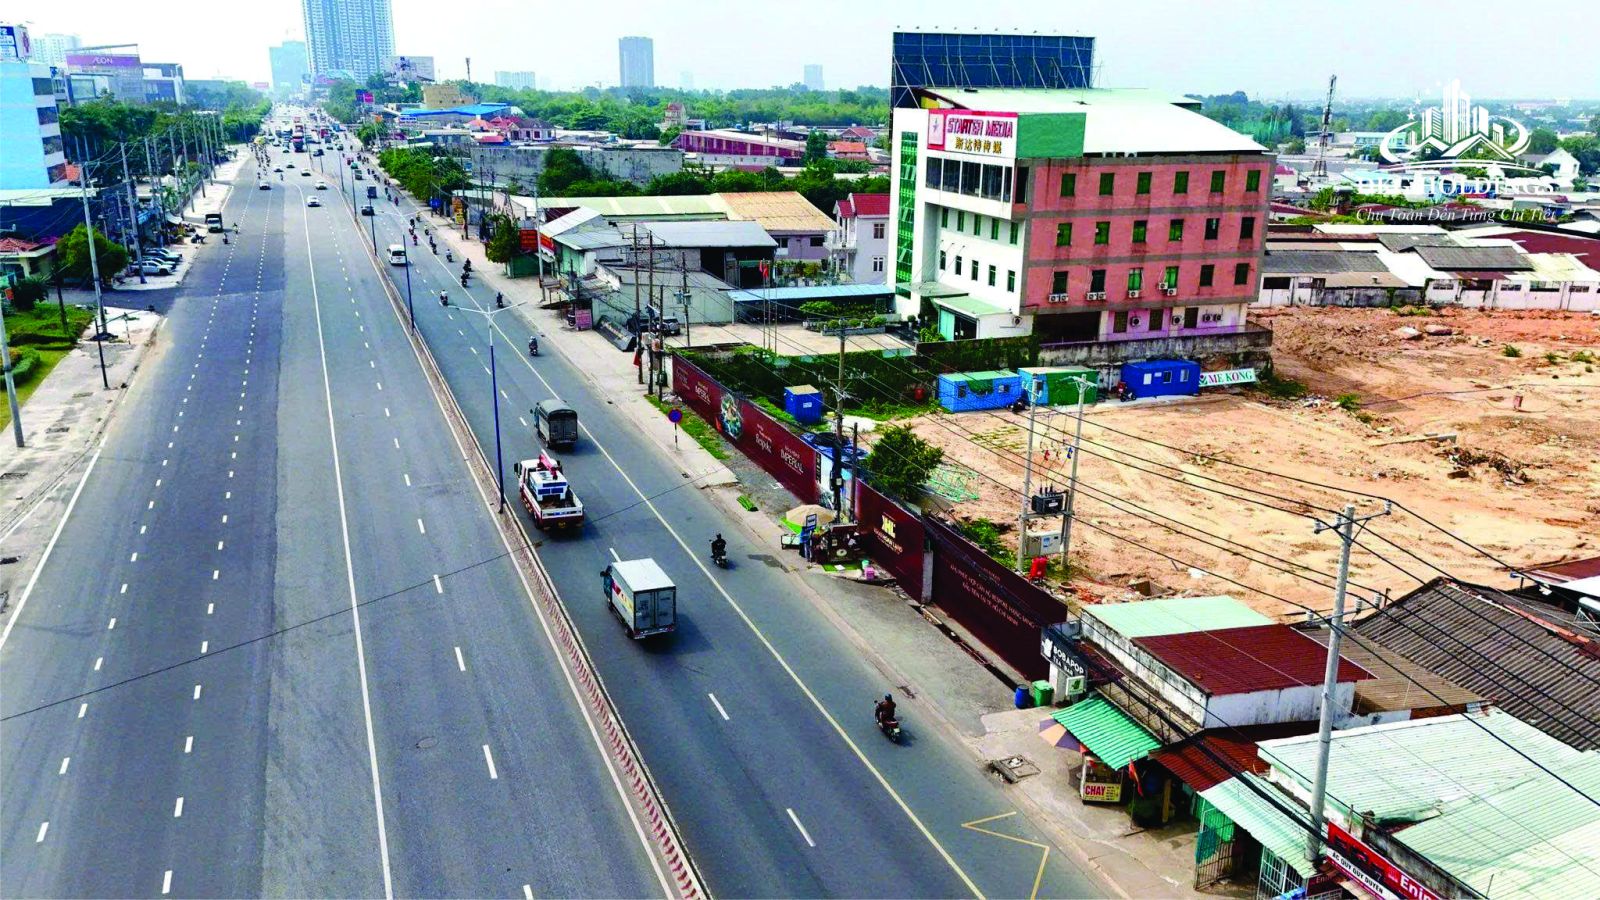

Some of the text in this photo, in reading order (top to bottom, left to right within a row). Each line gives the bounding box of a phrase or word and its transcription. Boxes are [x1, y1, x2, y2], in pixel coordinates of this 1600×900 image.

[947, 118, 1013, 138] STARTER MEDIA
[1208, 371, 1252, 384] ME KONG
[1052, 645, 1084, 675] BOBAPOP
[1085, 785, 1106, 796] CHAY
